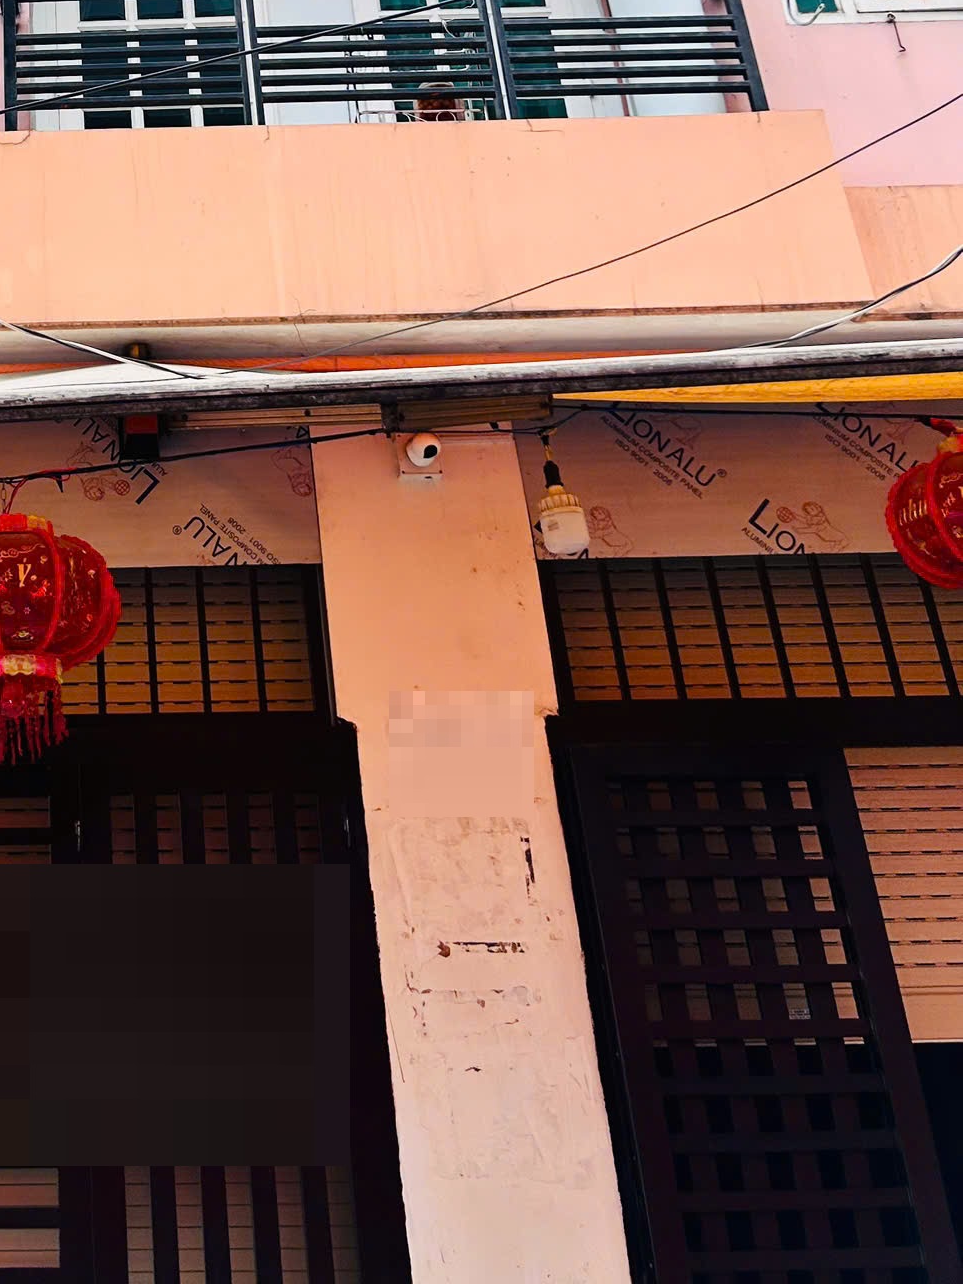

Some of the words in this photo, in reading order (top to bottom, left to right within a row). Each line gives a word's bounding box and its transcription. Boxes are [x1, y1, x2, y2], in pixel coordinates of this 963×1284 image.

[639, 444, 680, 479] COMPOSITE
[679, 477, 703, 499] PANEL
[848, 439, 894, 476] COMPOSITE
[199, 503, 221, 526] PANEL
[227, 516, 247, 535] 2008
[218, 522, 258, 560] COMPOSITE
[248, 536, 268, 555] 9001
